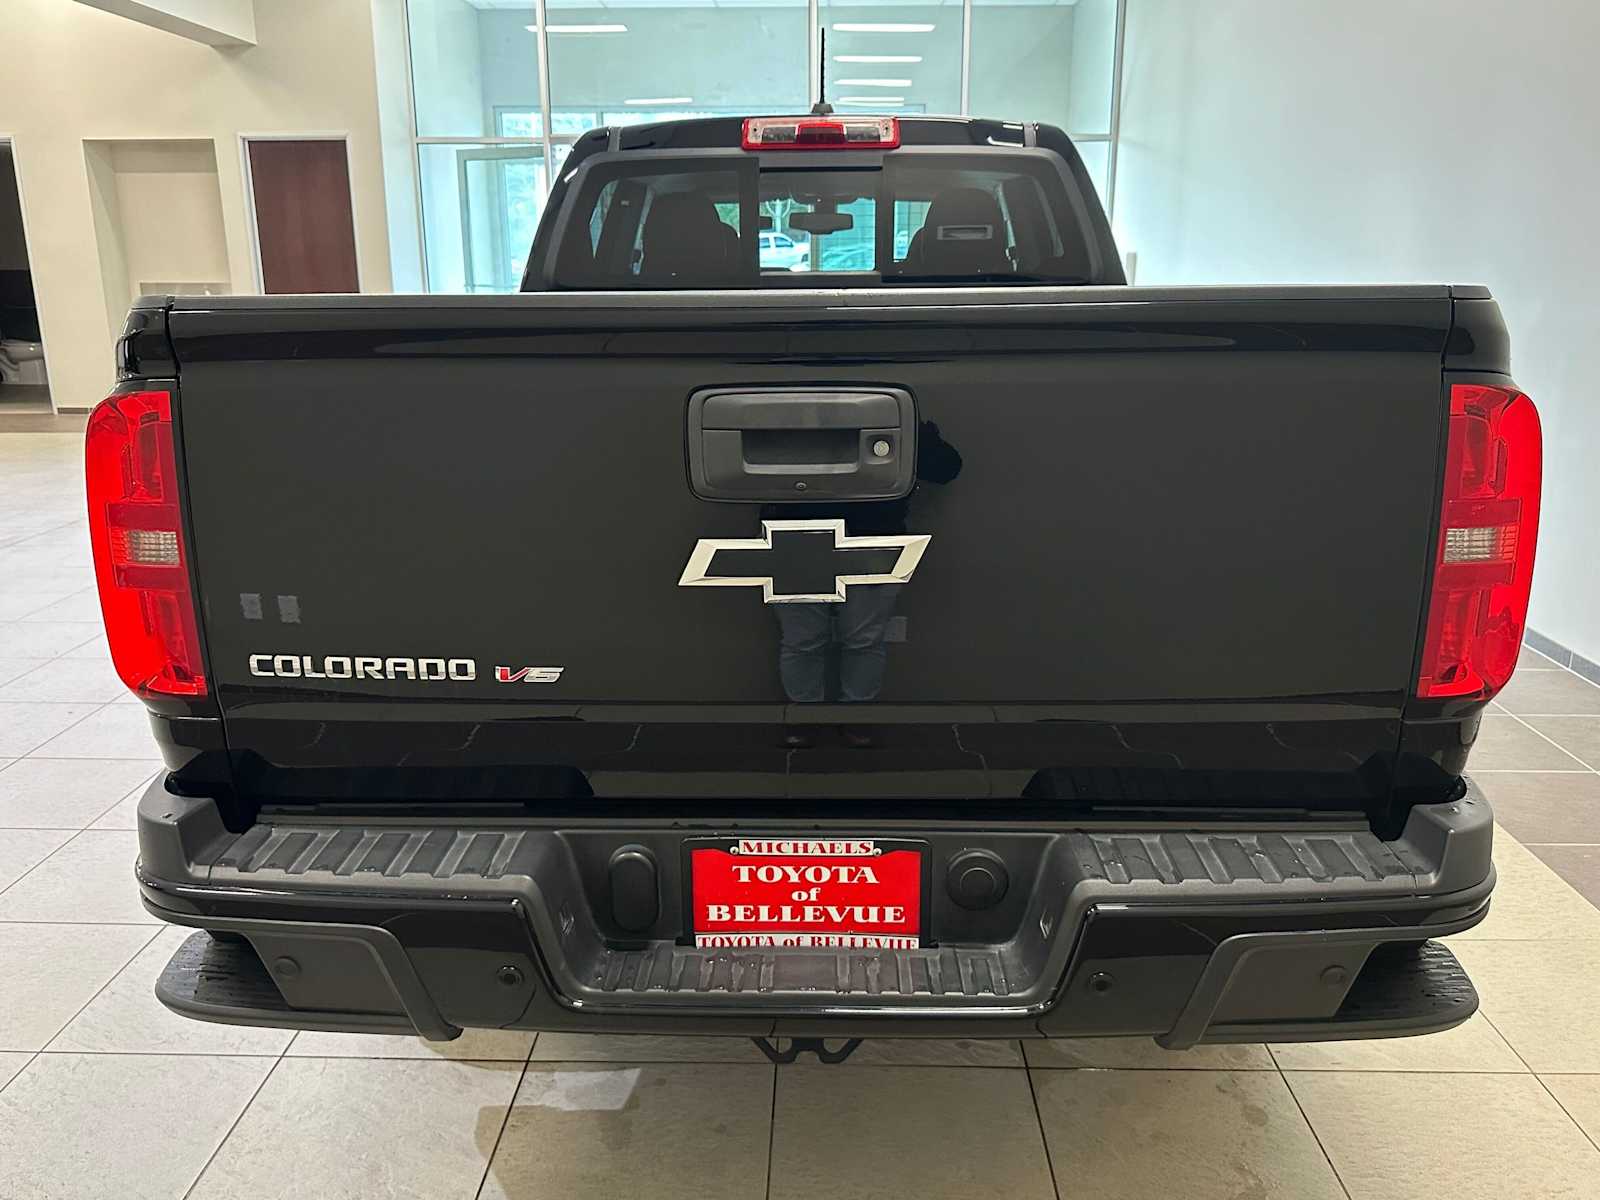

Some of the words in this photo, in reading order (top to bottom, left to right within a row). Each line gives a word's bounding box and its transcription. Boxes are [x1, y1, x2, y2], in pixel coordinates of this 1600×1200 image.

[249, 654, 477, 681] COLORADO
[495, 666, 564, 683] V6
[742, 841, 872, 855] MICHAELS
[732, 865, 880, 884] TOYOTA
[791, 887, 821, 902] of
[706, 904, 906, 923] BELLEVUE
[697, 936, 776, 948] TOYOTA
[783, 937, 804, 948] of
[810, 936, 918, 950] BELLEVUE
